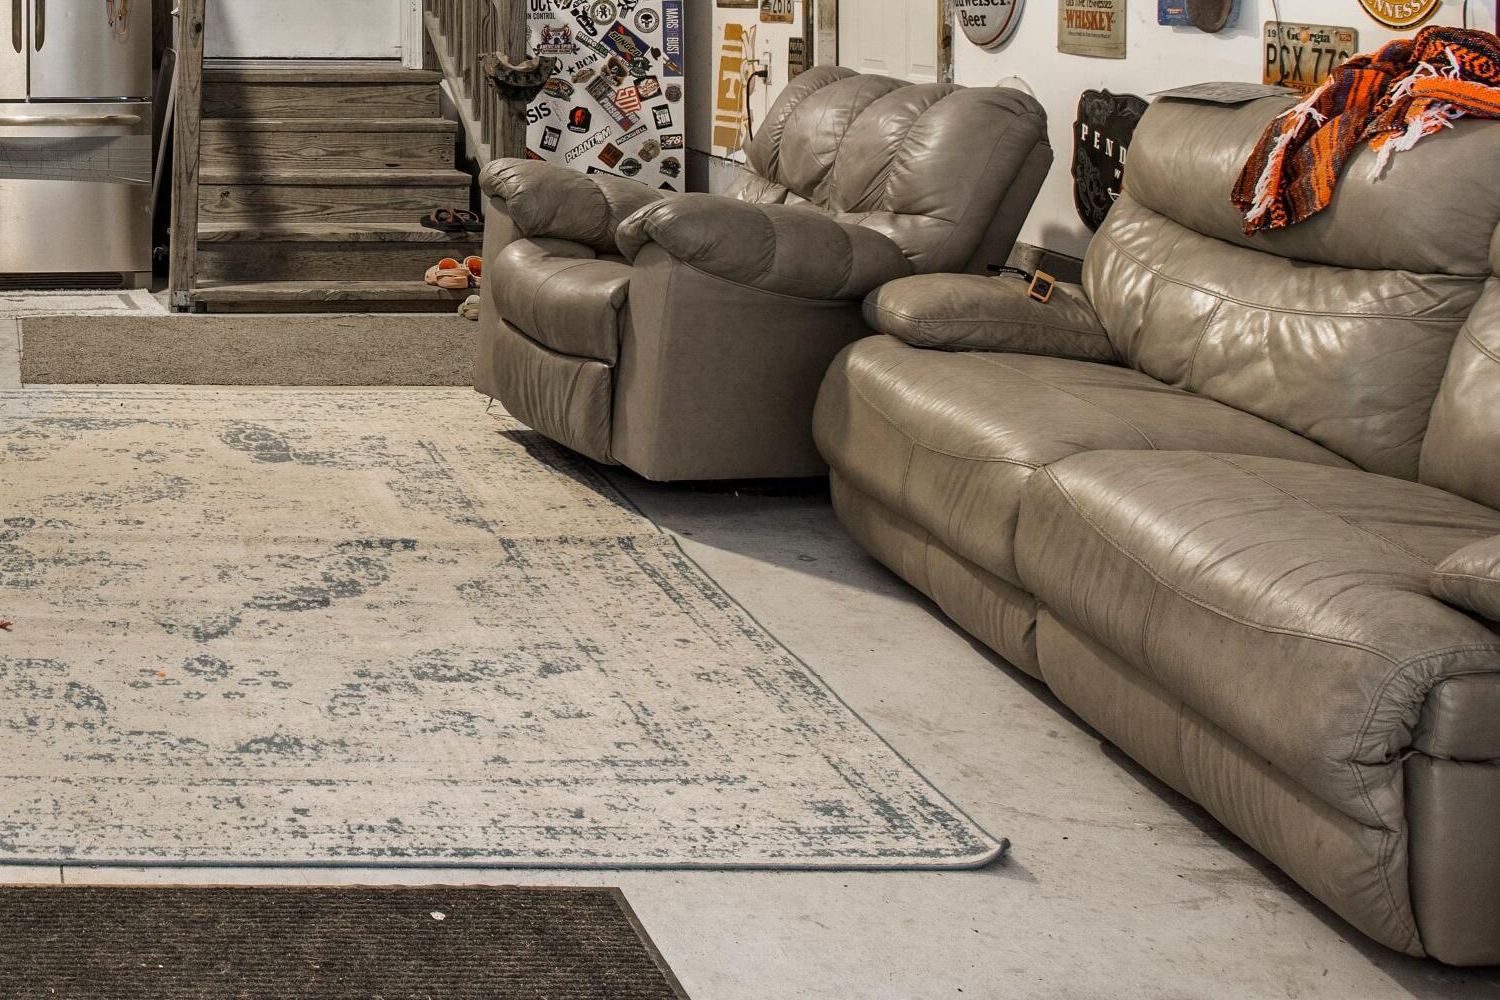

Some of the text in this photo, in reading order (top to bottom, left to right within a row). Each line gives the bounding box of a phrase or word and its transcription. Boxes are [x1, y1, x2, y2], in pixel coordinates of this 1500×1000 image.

[533, 12, 556, 20] CONTROL
[961, 11, 987, 28] Beer
[1066, 11, 1115, 32] WHISKEY
[665, 7, 679, 56] MARS BUST
[609, 30, 642, 57] SUNOCO
[574, 53, 598, 70] BCM
[1266, 43, 1303, 82] PCX
[599, 97, 625, 122] PRISON
[616, 125, 648, 144] ROCKWELL
